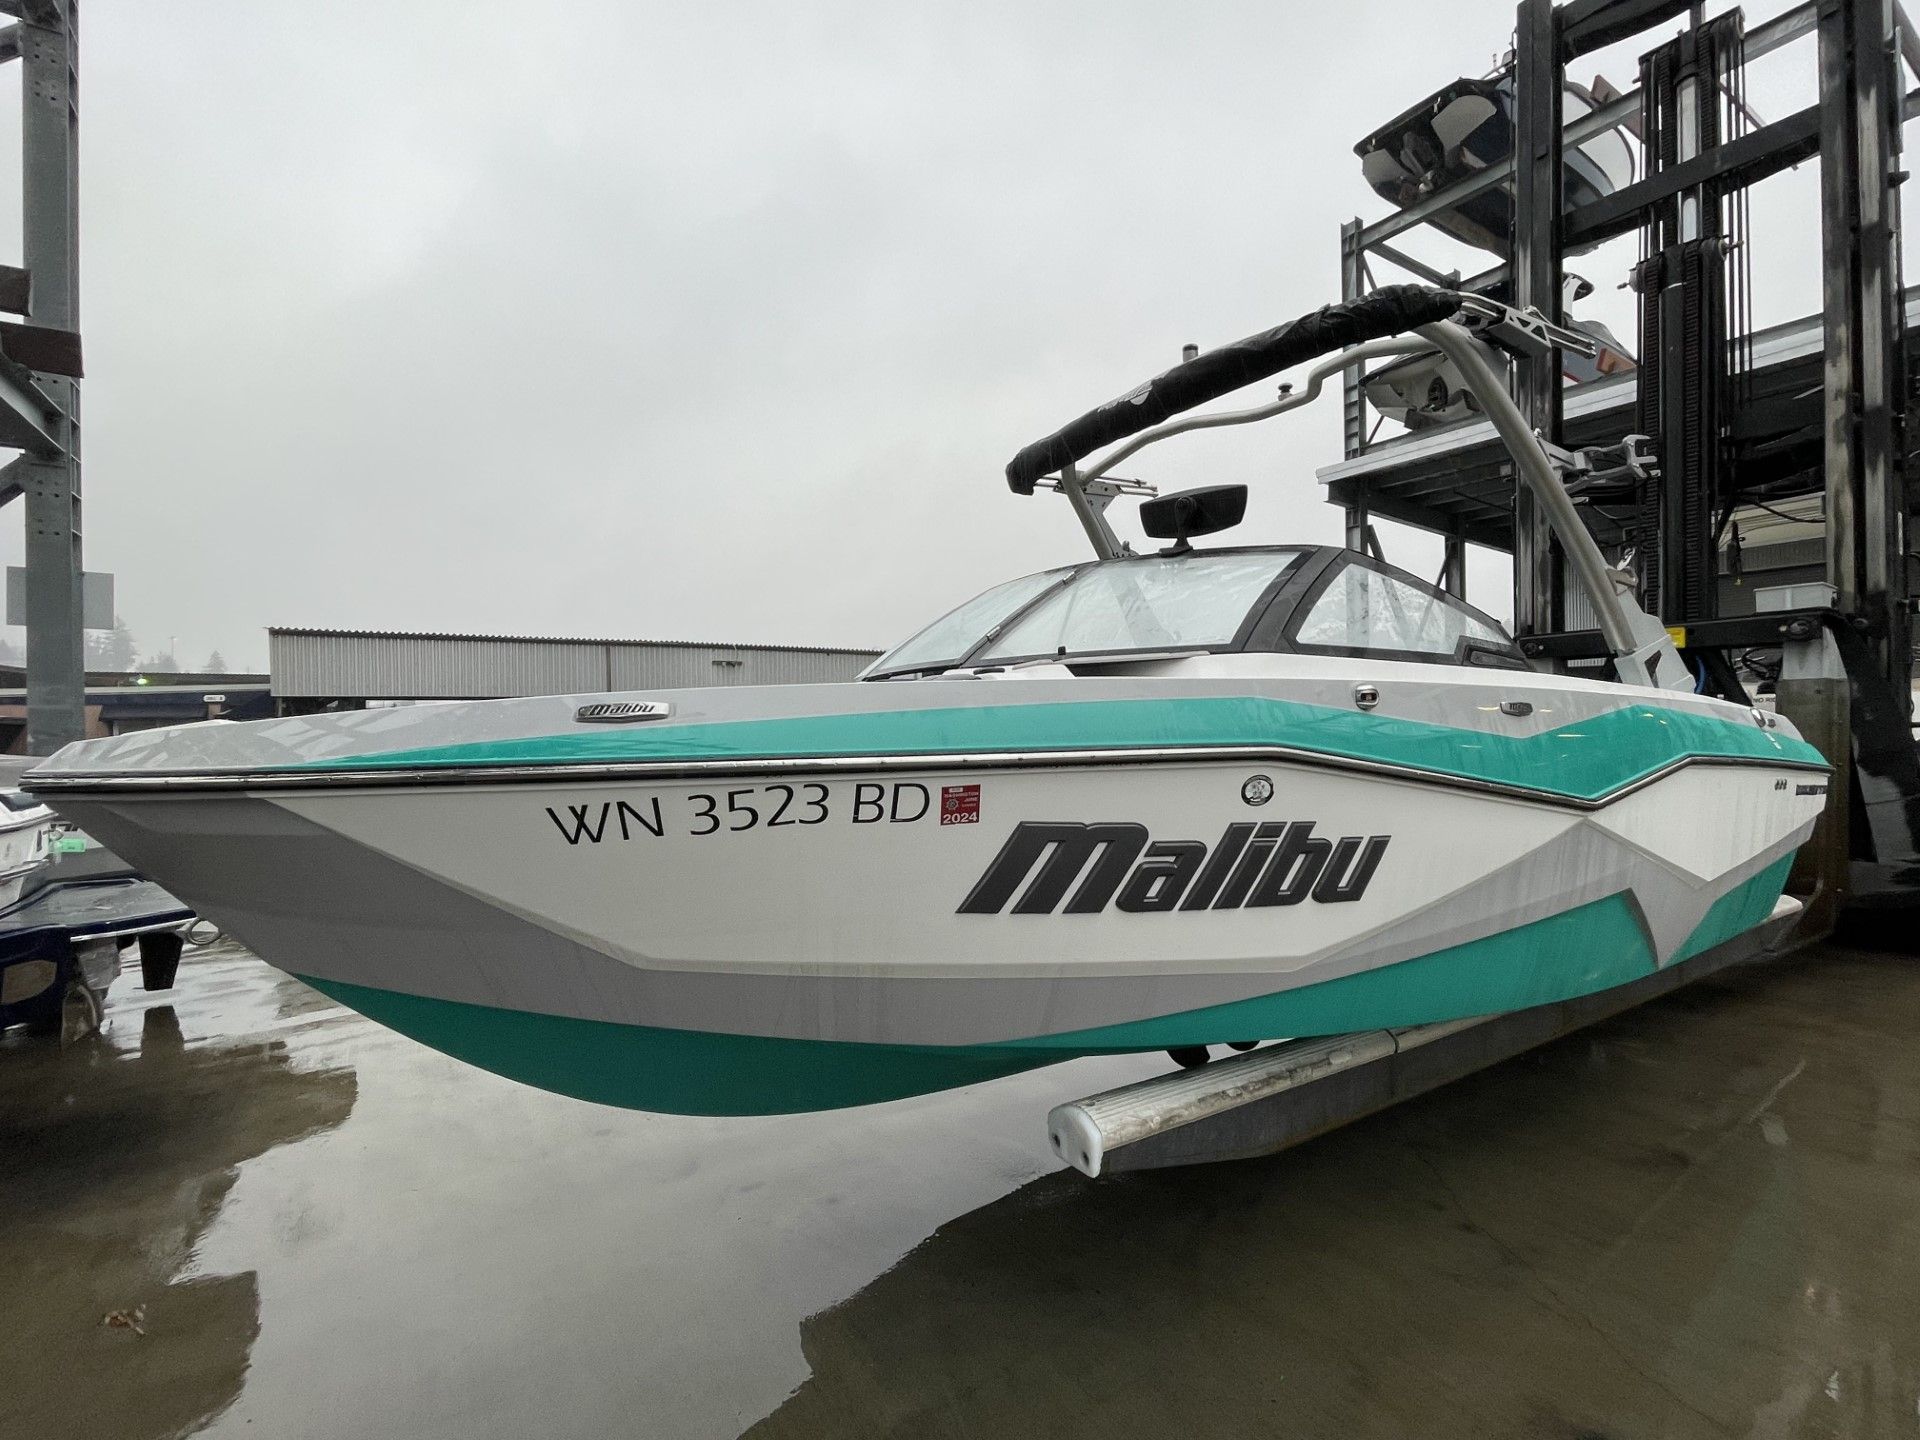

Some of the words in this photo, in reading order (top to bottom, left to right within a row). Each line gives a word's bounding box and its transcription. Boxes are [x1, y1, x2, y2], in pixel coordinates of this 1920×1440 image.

[589, 702, 656, 716] Malibu
[546, 796, 664, 845] WN
[688, 782, 829, 836] 3523
[852, 782, 930, 823] BD
[943, 812, 977, 824] 2024
[956, 821, 1392, 914] Malibu
